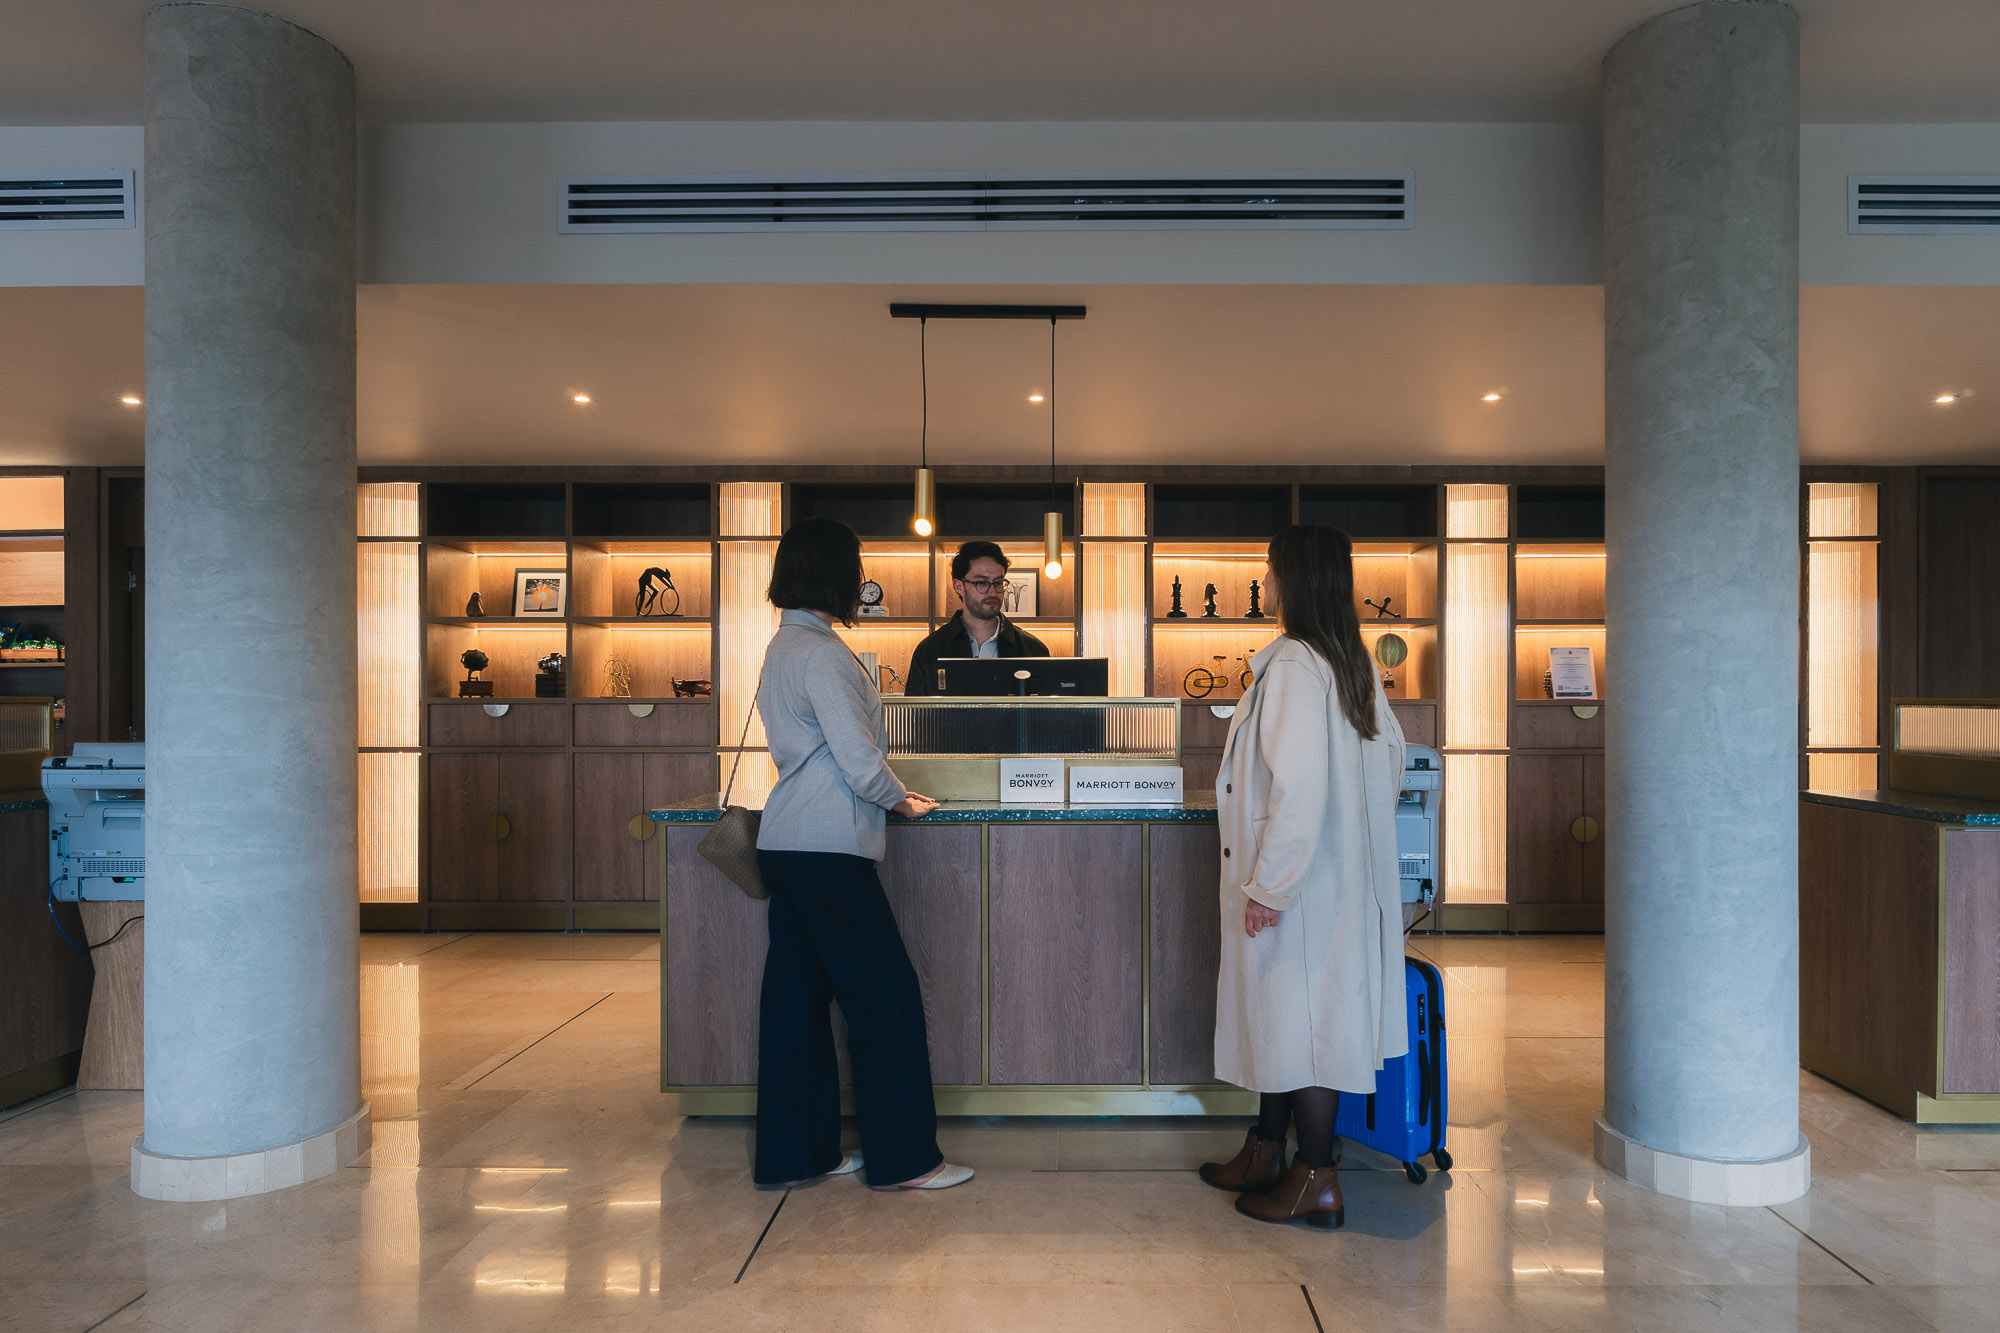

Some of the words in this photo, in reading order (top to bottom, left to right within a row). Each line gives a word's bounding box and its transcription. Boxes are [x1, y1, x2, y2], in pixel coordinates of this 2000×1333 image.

[1009, 779, 1054, 788] BONVOY
[1076, 781, 1131, 789] MARRIOTT
[1134, 781, 1176, 789] BONVOY
